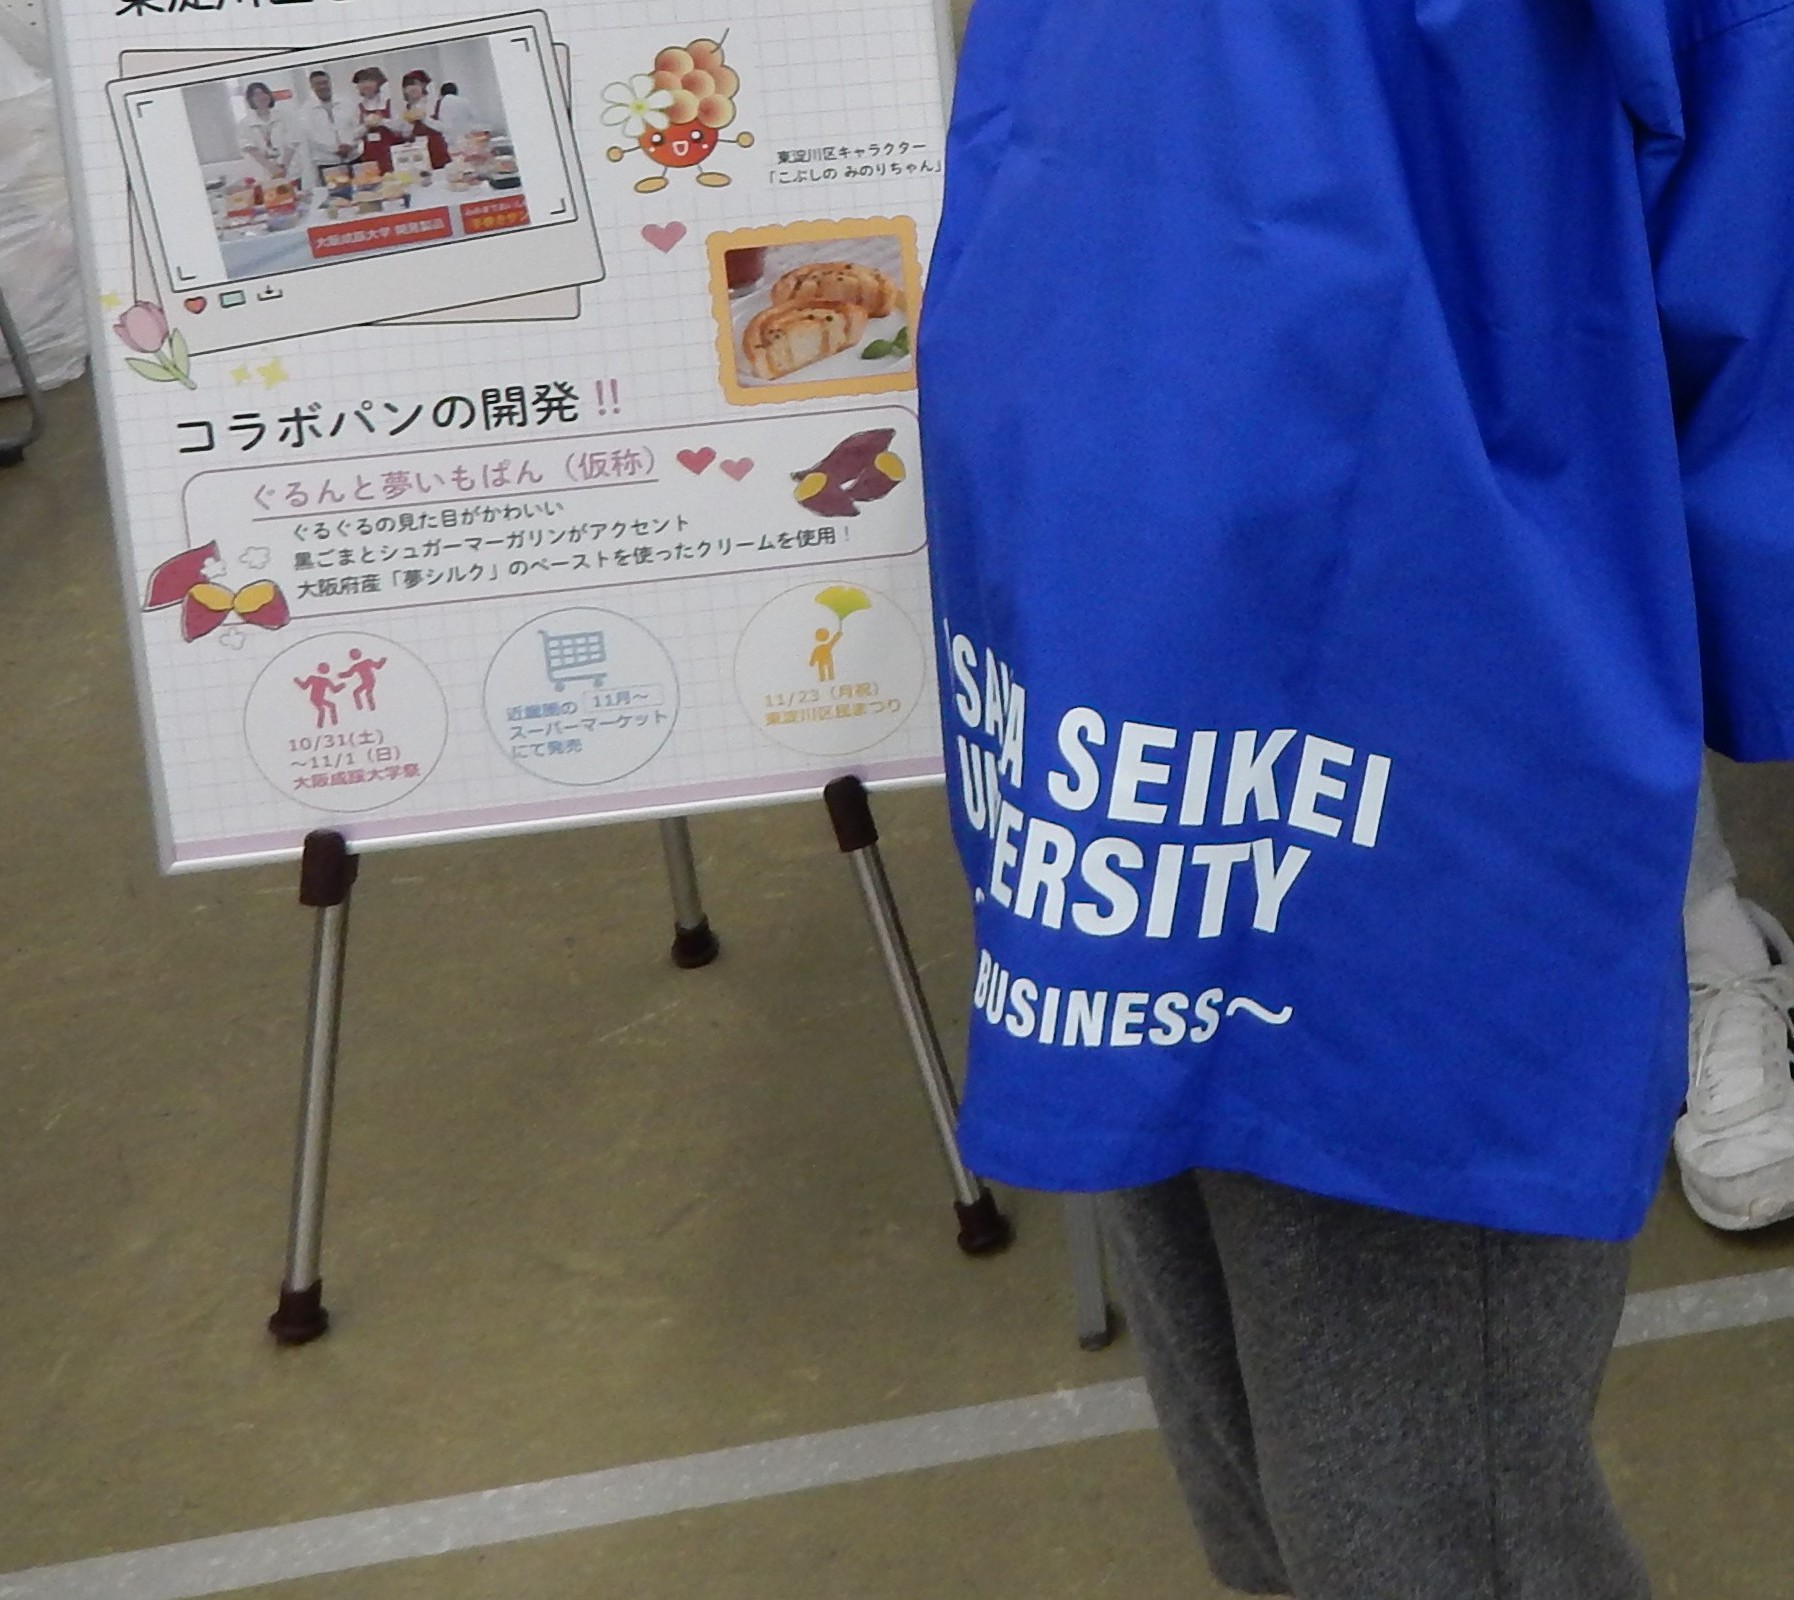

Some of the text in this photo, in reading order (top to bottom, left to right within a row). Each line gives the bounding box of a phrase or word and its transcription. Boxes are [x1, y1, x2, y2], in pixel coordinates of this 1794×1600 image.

[292, 500, 565, 542] ぐるぐるの見た目がかわいい
[294, 515, 689, 571] 黒ごまとシュガーマーガリンがアクセント
[1047, 705, 1393, 849] SEIKEI
